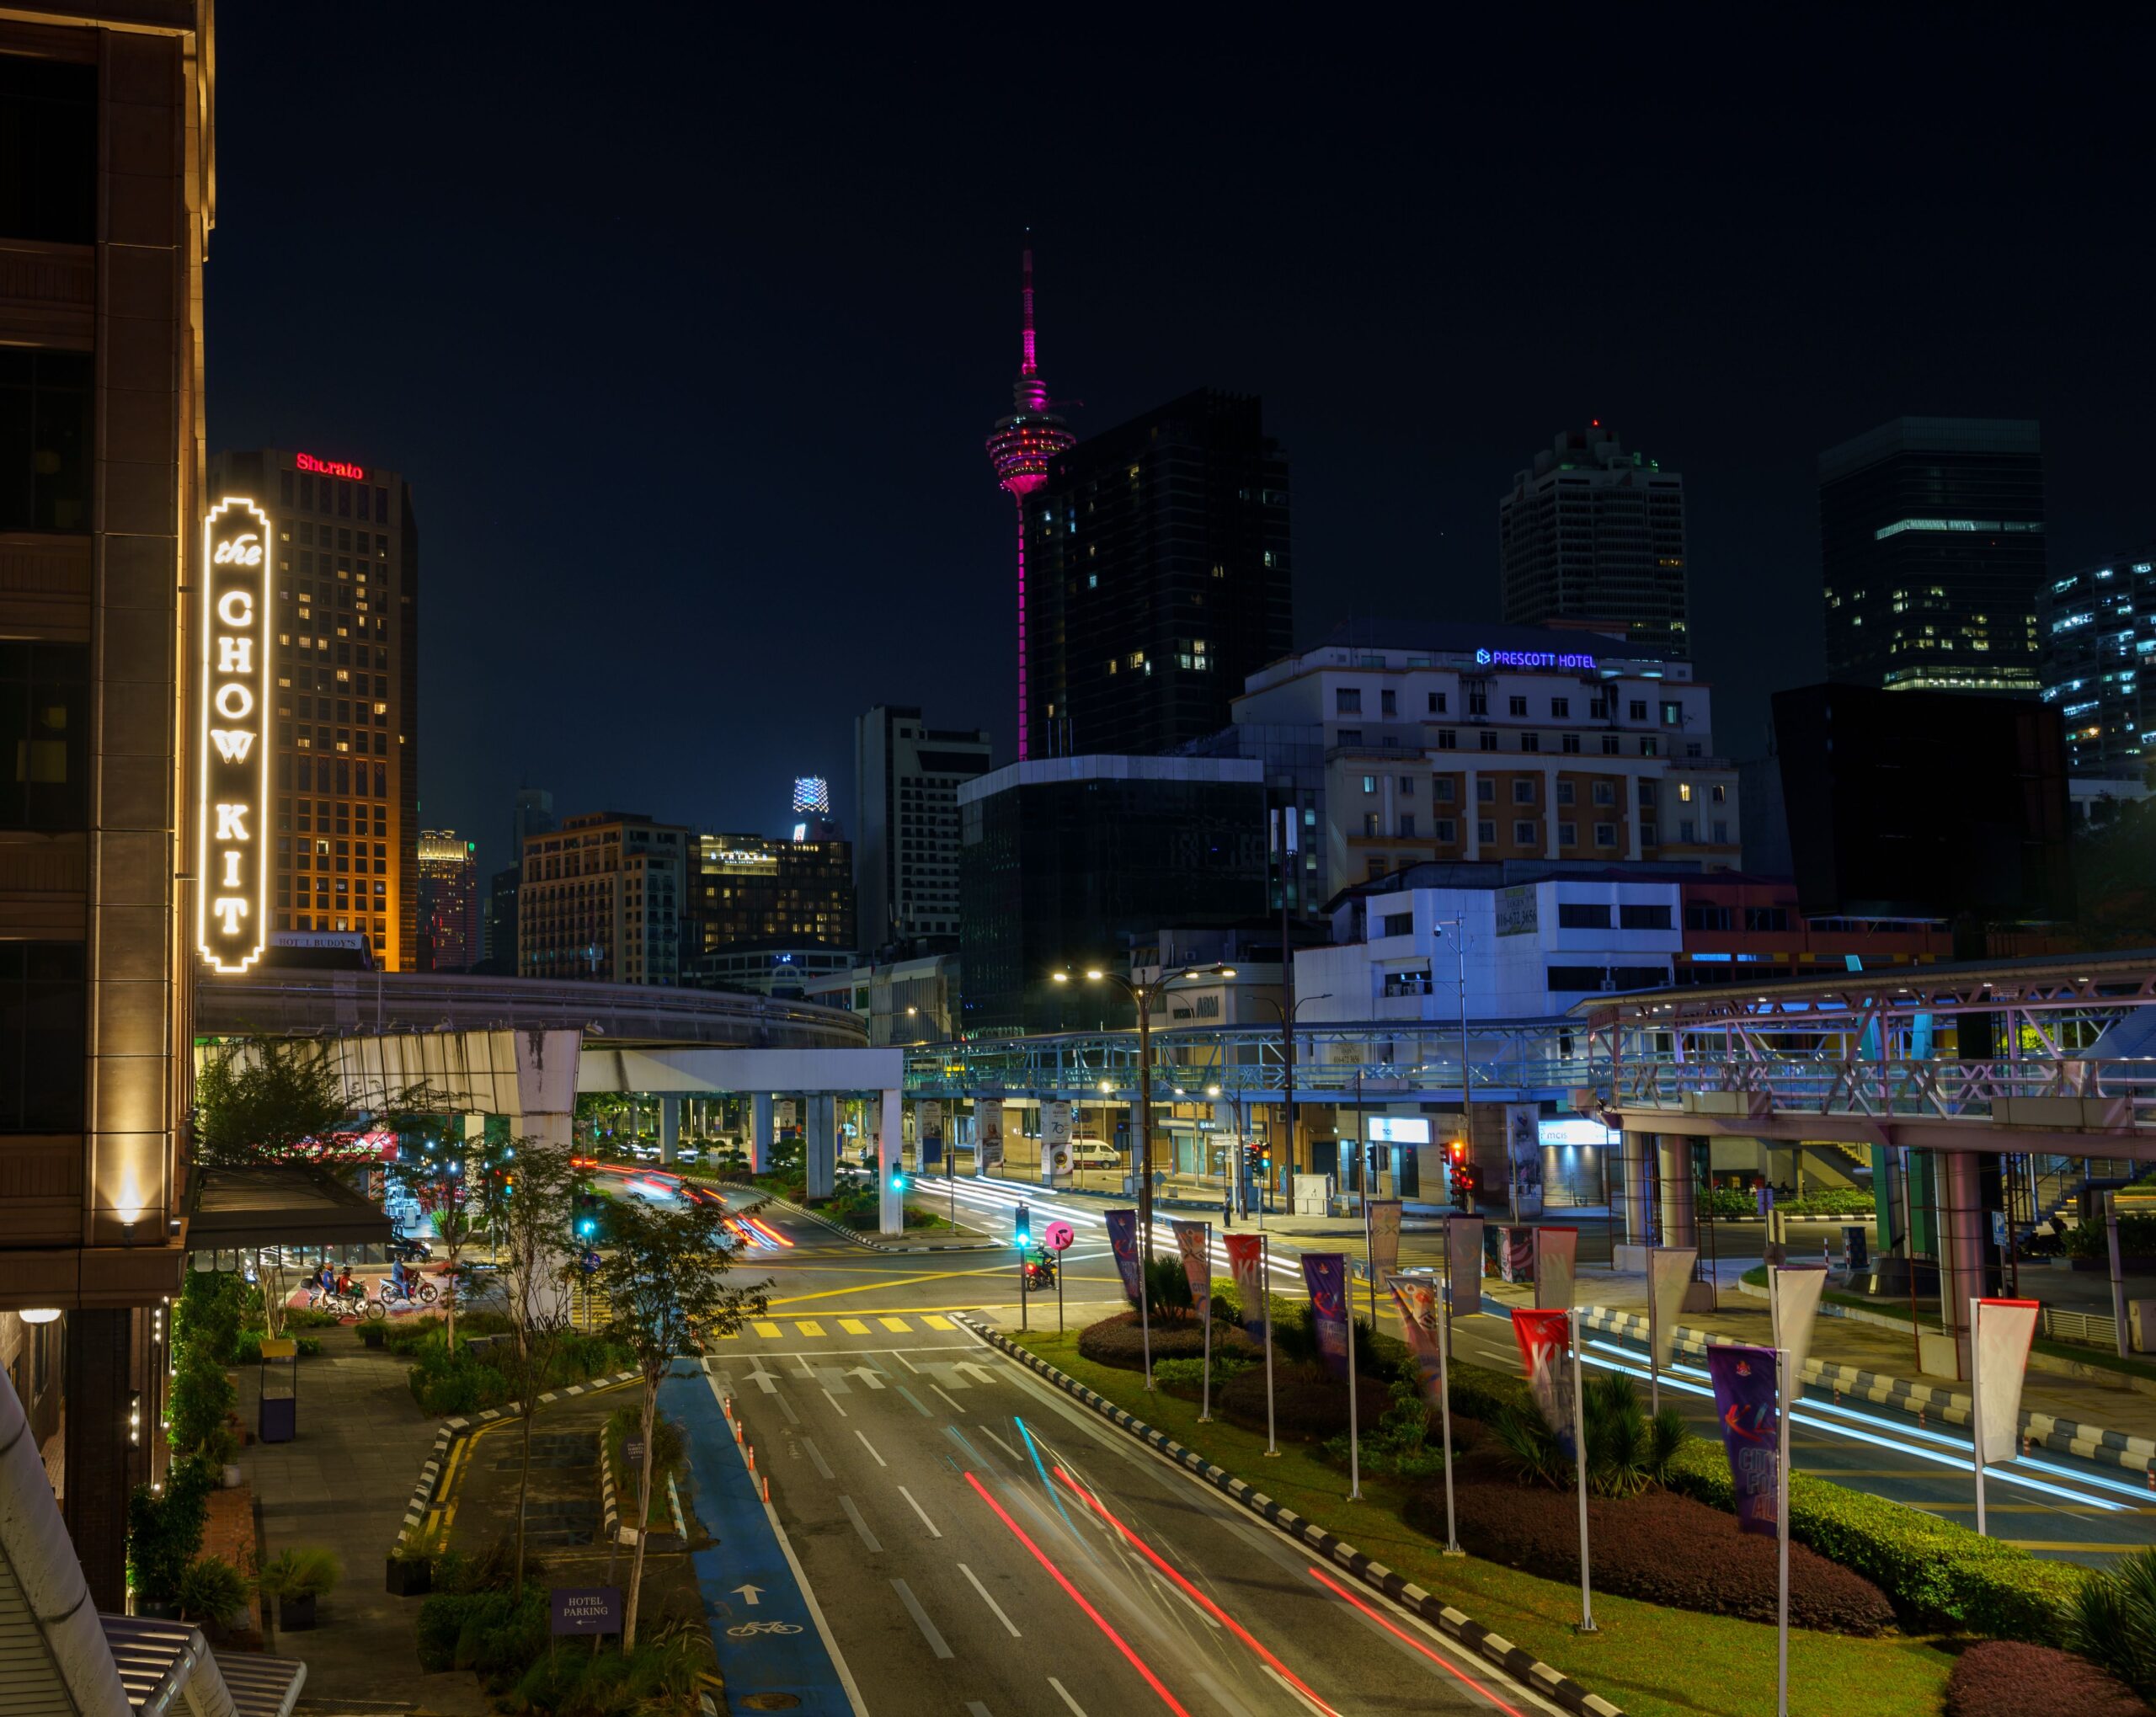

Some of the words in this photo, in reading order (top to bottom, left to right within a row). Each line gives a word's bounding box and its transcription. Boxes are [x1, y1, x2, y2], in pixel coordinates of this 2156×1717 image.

[214, 533, 262, 566] the
[1493, 652, 1555, 666] PRESCOTT
[1559, 654, 1596, 669] HOTEL
[211, 591, 257, 764] CHOW
[215, 803, 250, 935] KIT
[279, 938, 312, 946] HOTL
[1738, 1447, 1776, 1472] CITY
[563, 1607, 608, 1617] PARKING
[568, 1597, 603, 1606] HOTEL
